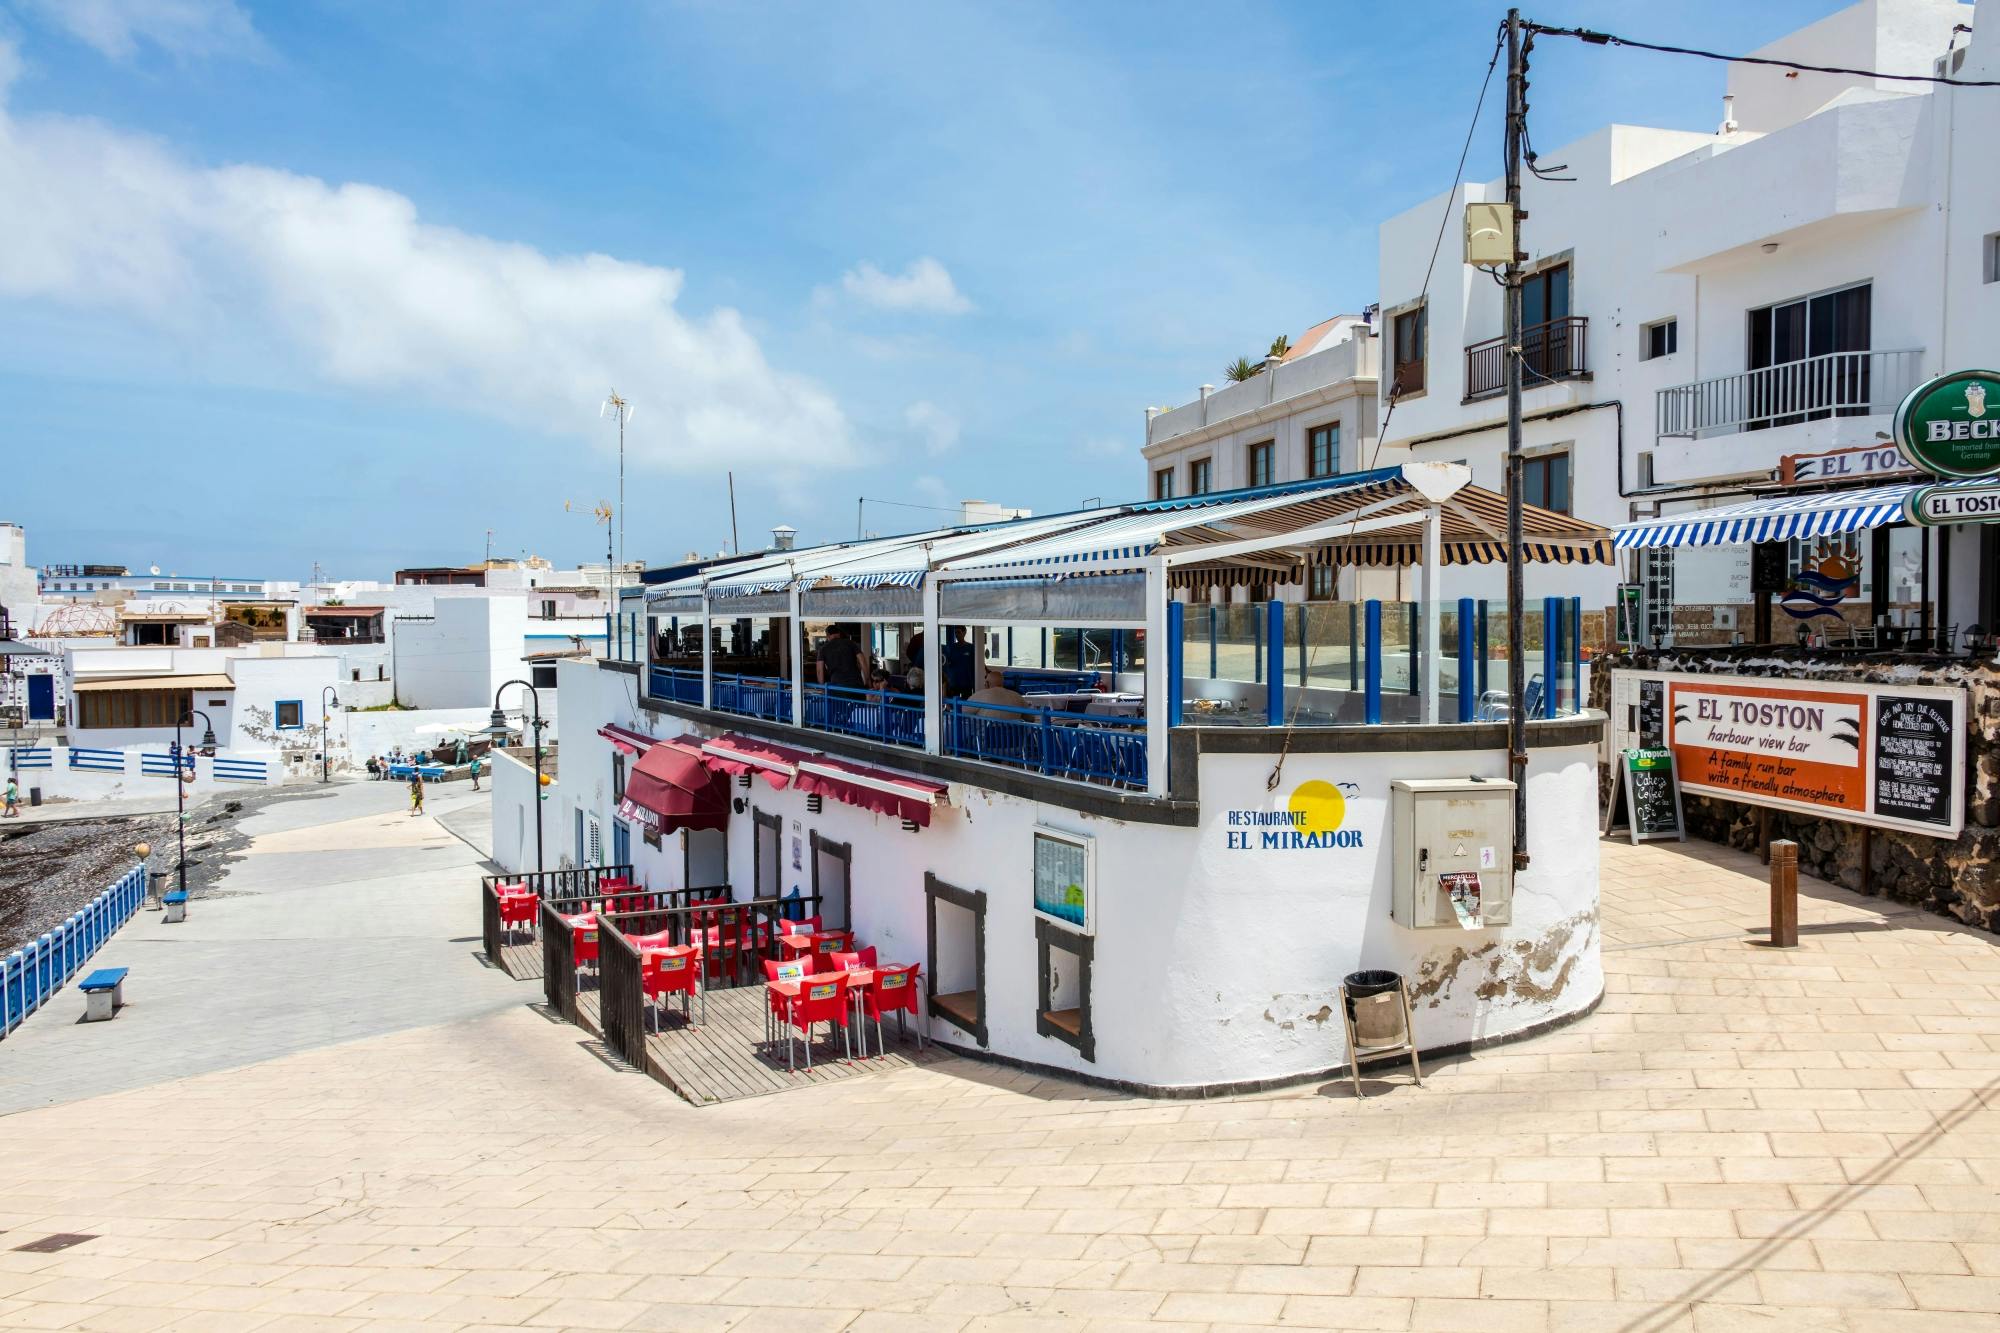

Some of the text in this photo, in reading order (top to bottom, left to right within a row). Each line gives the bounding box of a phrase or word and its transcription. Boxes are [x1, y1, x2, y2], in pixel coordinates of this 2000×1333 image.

[1952, 442, 1983, 452] Imported
[1960, 452, 1990, 461] Germany
[1821, 455, 1851, 475] EL
[1933, 495, 2000, 515] EL TOST
[1698, 698, 1824, 732] EL TOSTON
[1892, 703, 1902, 714] AND
[1904, 702, 1915, 713] TRY
[1917, 704, 1928, 714] OUR
[1707, 725, 1810, 753] harbour view bar
[1640, 748, 1671, 759] Tropical
[1708, 750, 1797, 777] A family run bar
[1708, 770, 1846, 804] with a friendly atmosphere
[1228, 810, 1307, 826] RESTAURANTE
[1227, 830, 1363, 850] EL MIRADOR
